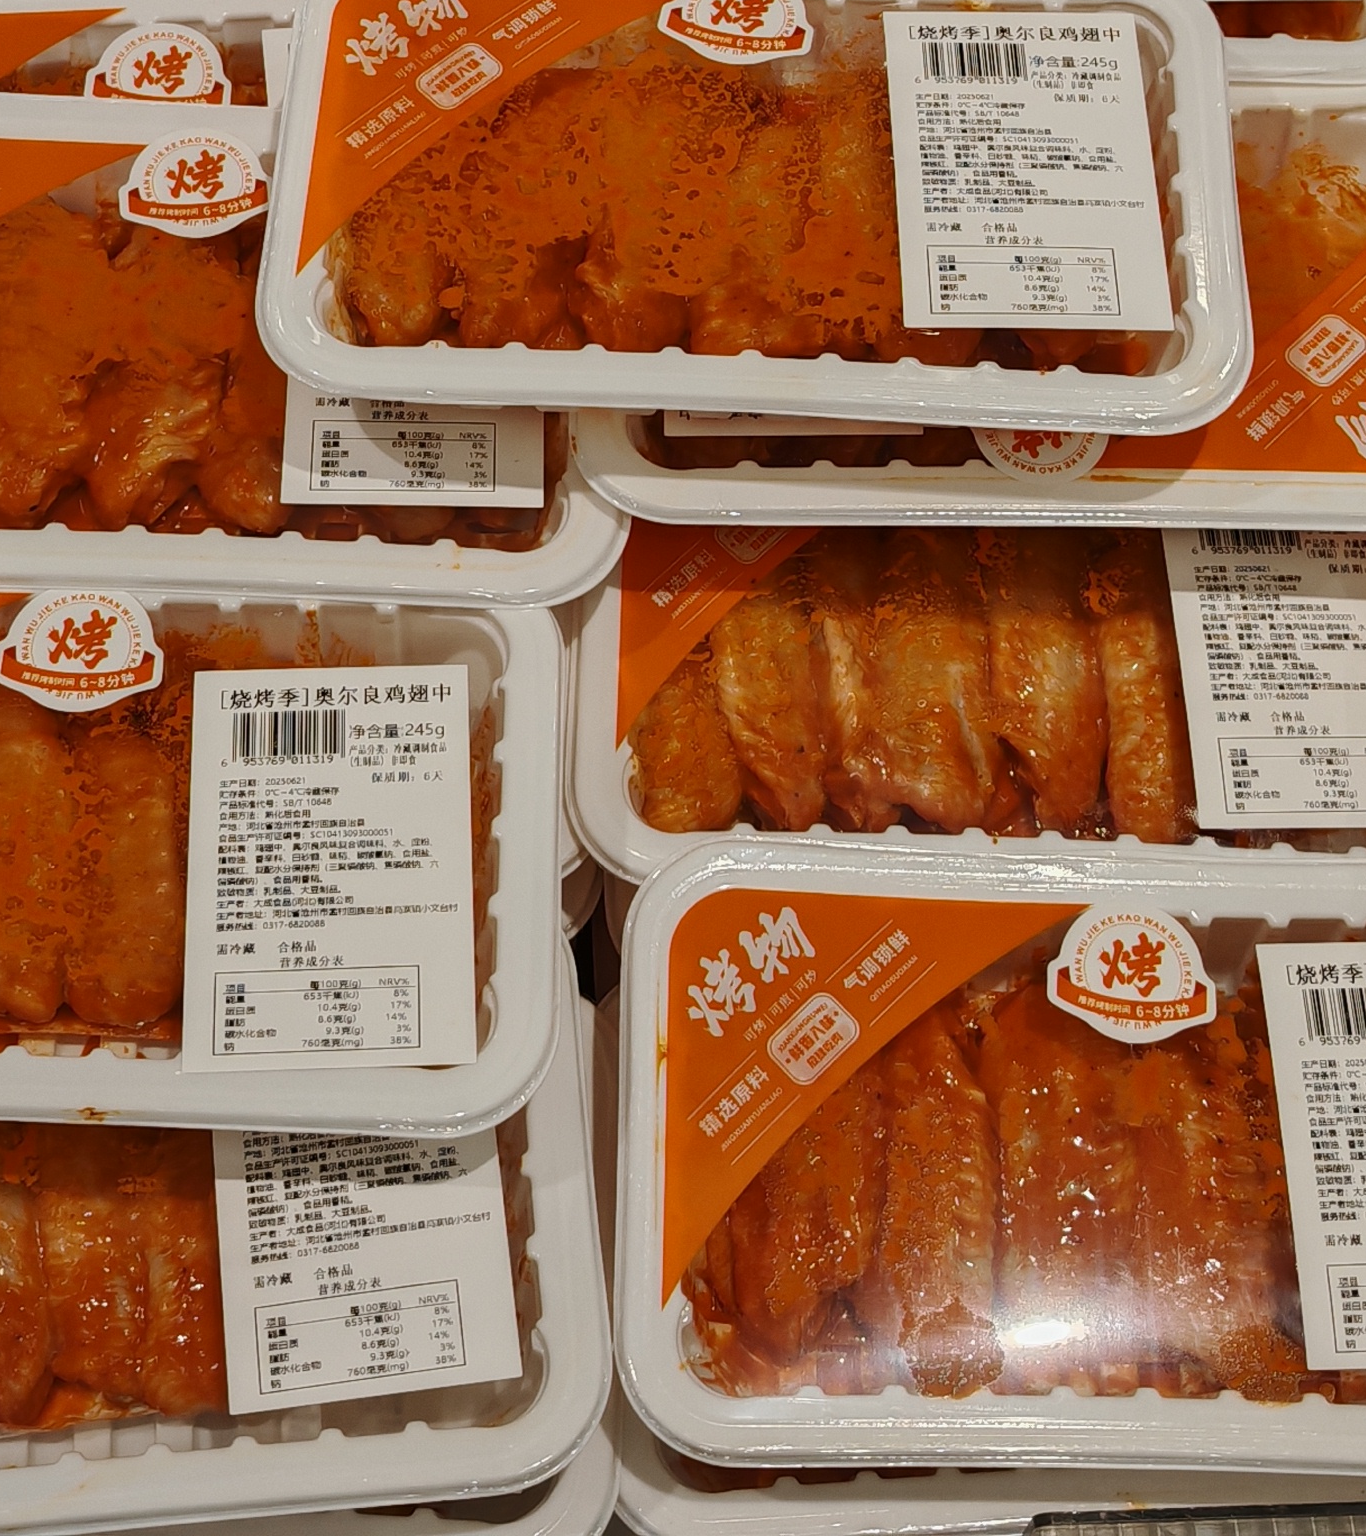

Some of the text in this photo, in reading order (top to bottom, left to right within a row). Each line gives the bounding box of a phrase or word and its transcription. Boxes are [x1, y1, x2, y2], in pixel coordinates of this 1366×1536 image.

[133, 45, 193, 94] 烤
[346, 96, 415, 147] 精选原料
[166, 149, 226, 200] 烤
[651, 549, 716, 607] 精选原料
[48, 609, 117, 669] 烤
[1099, 932, 1165, 997] 烤
[699, 1066, 769, 1136] 精选原料
